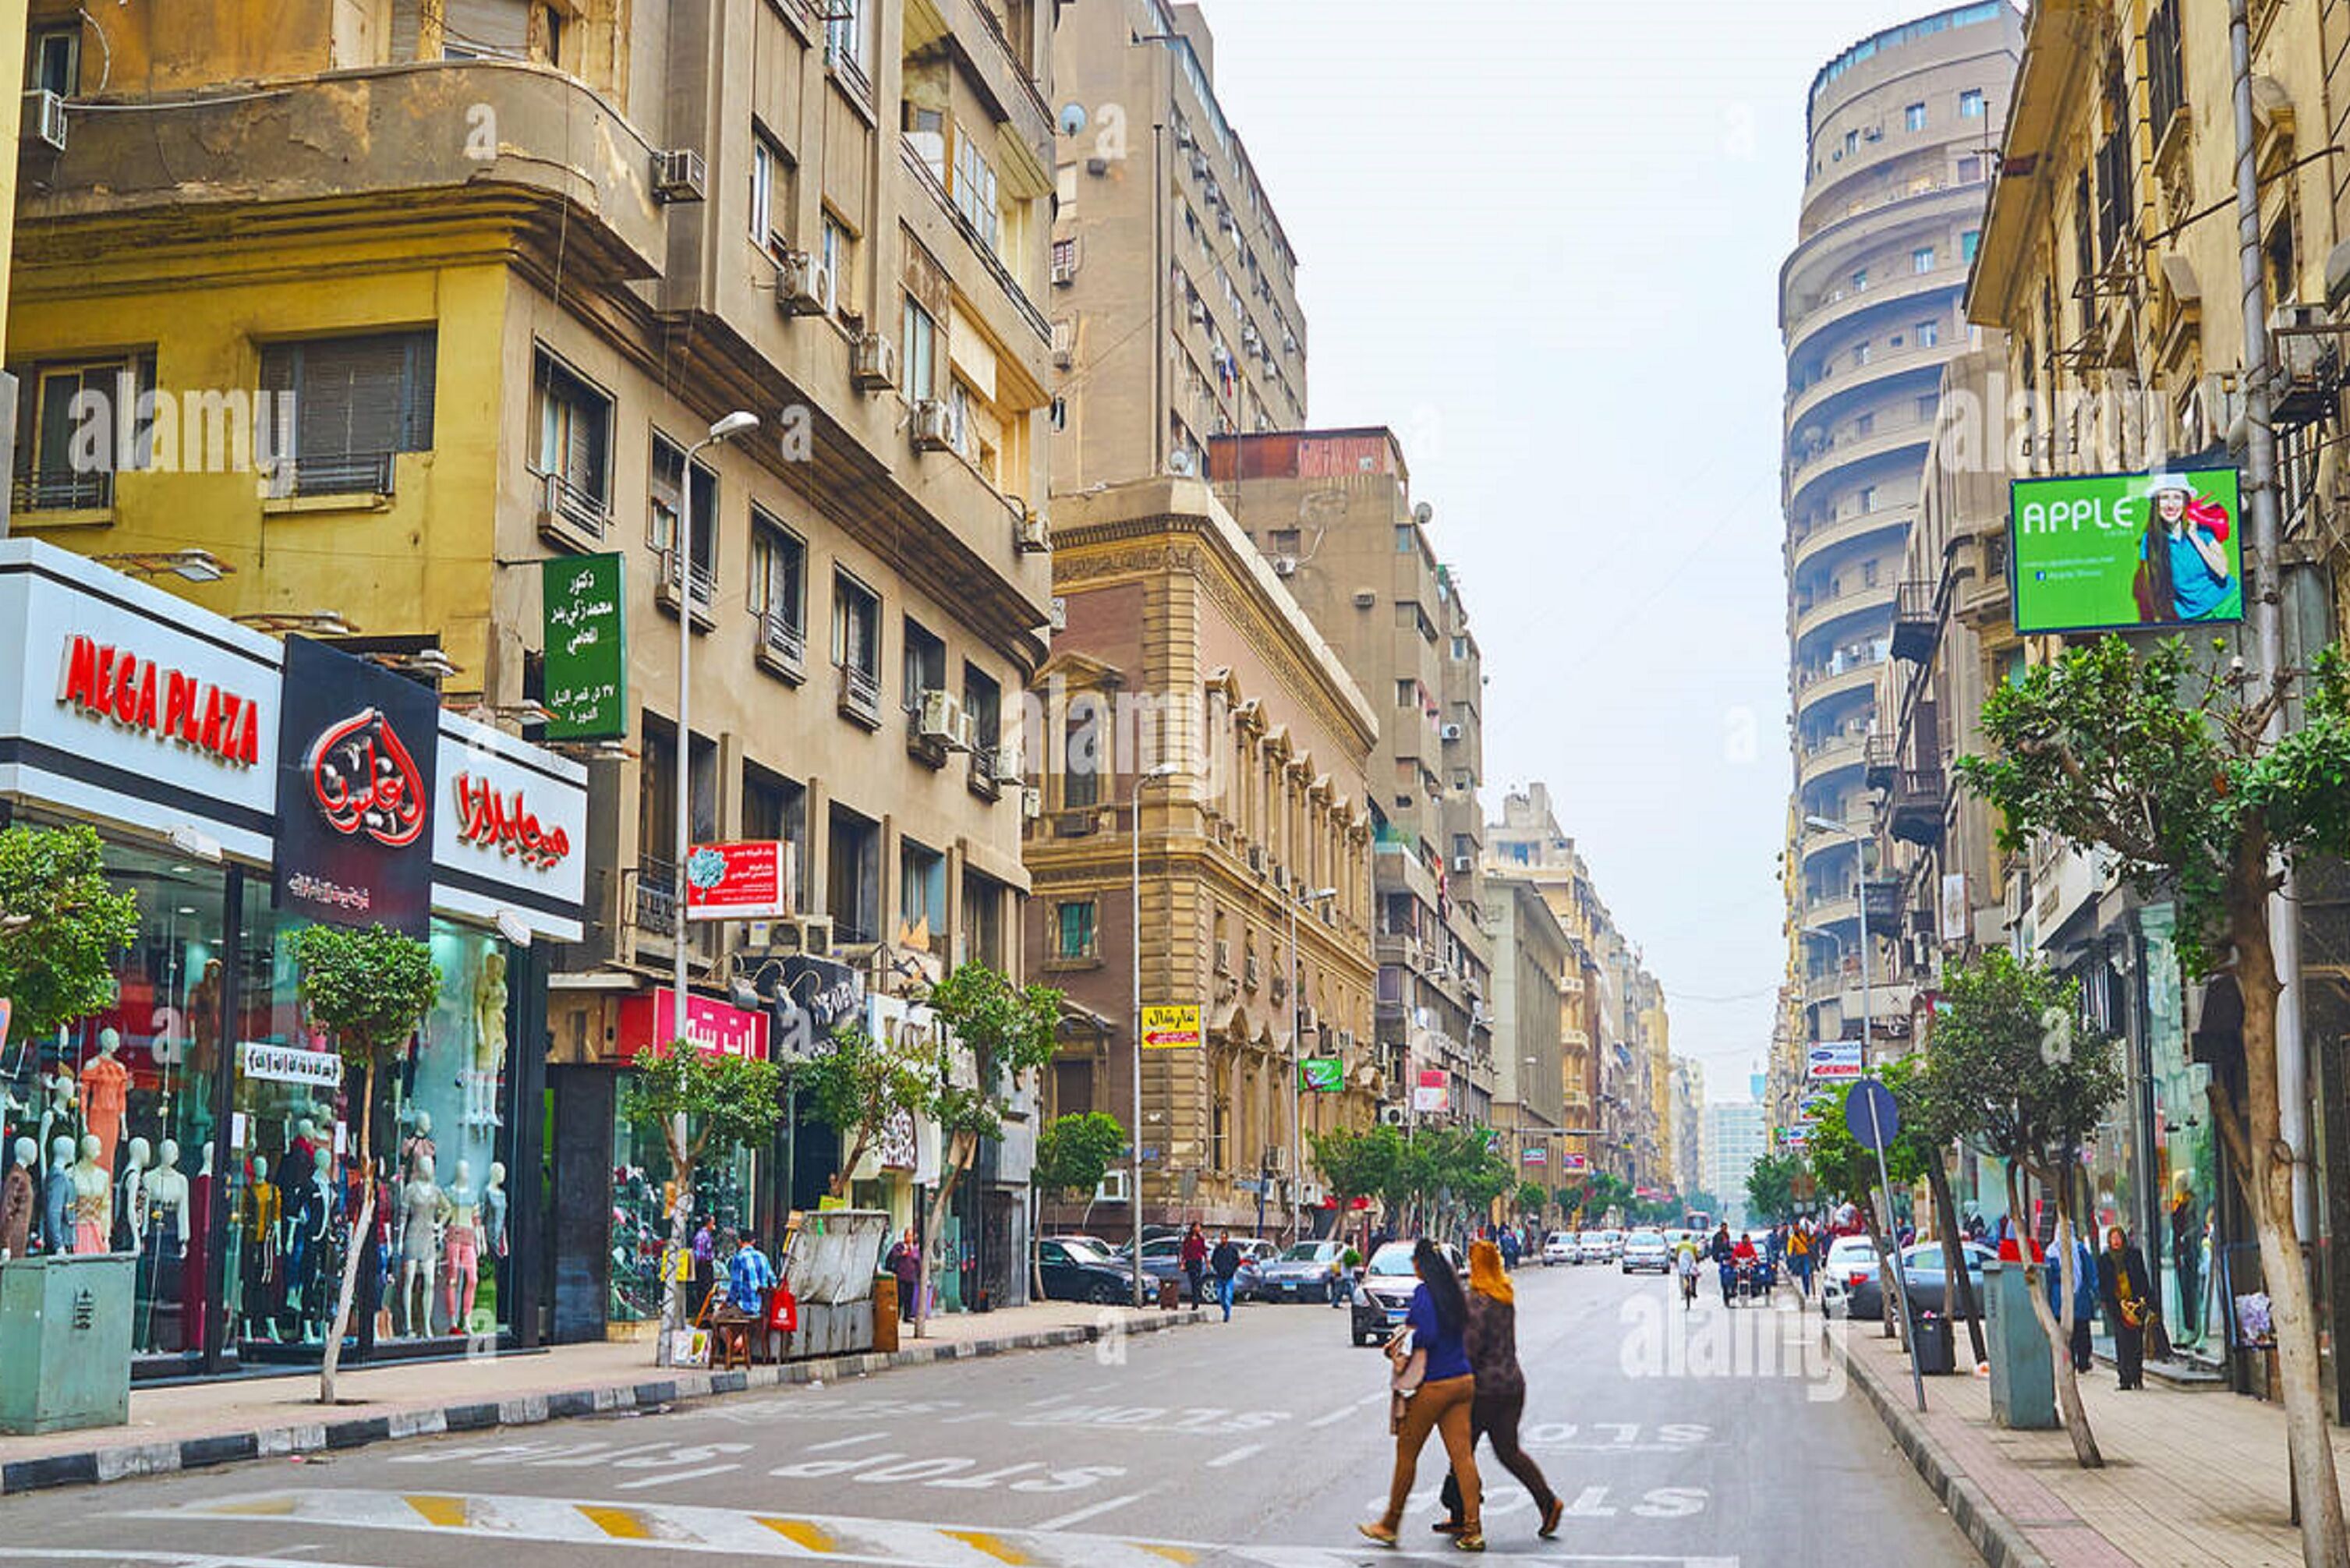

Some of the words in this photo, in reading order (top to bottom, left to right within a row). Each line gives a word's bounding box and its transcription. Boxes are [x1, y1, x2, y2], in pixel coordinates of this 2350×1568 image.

[2023, 497, 2135, 533] APPLE
[570, 569, 595, 595] دكتور
[58, 634, 157, 731] MEGA
[160, 668, 259, 766] PLAZA
[769, 1452, 1128, 1492] STOP
